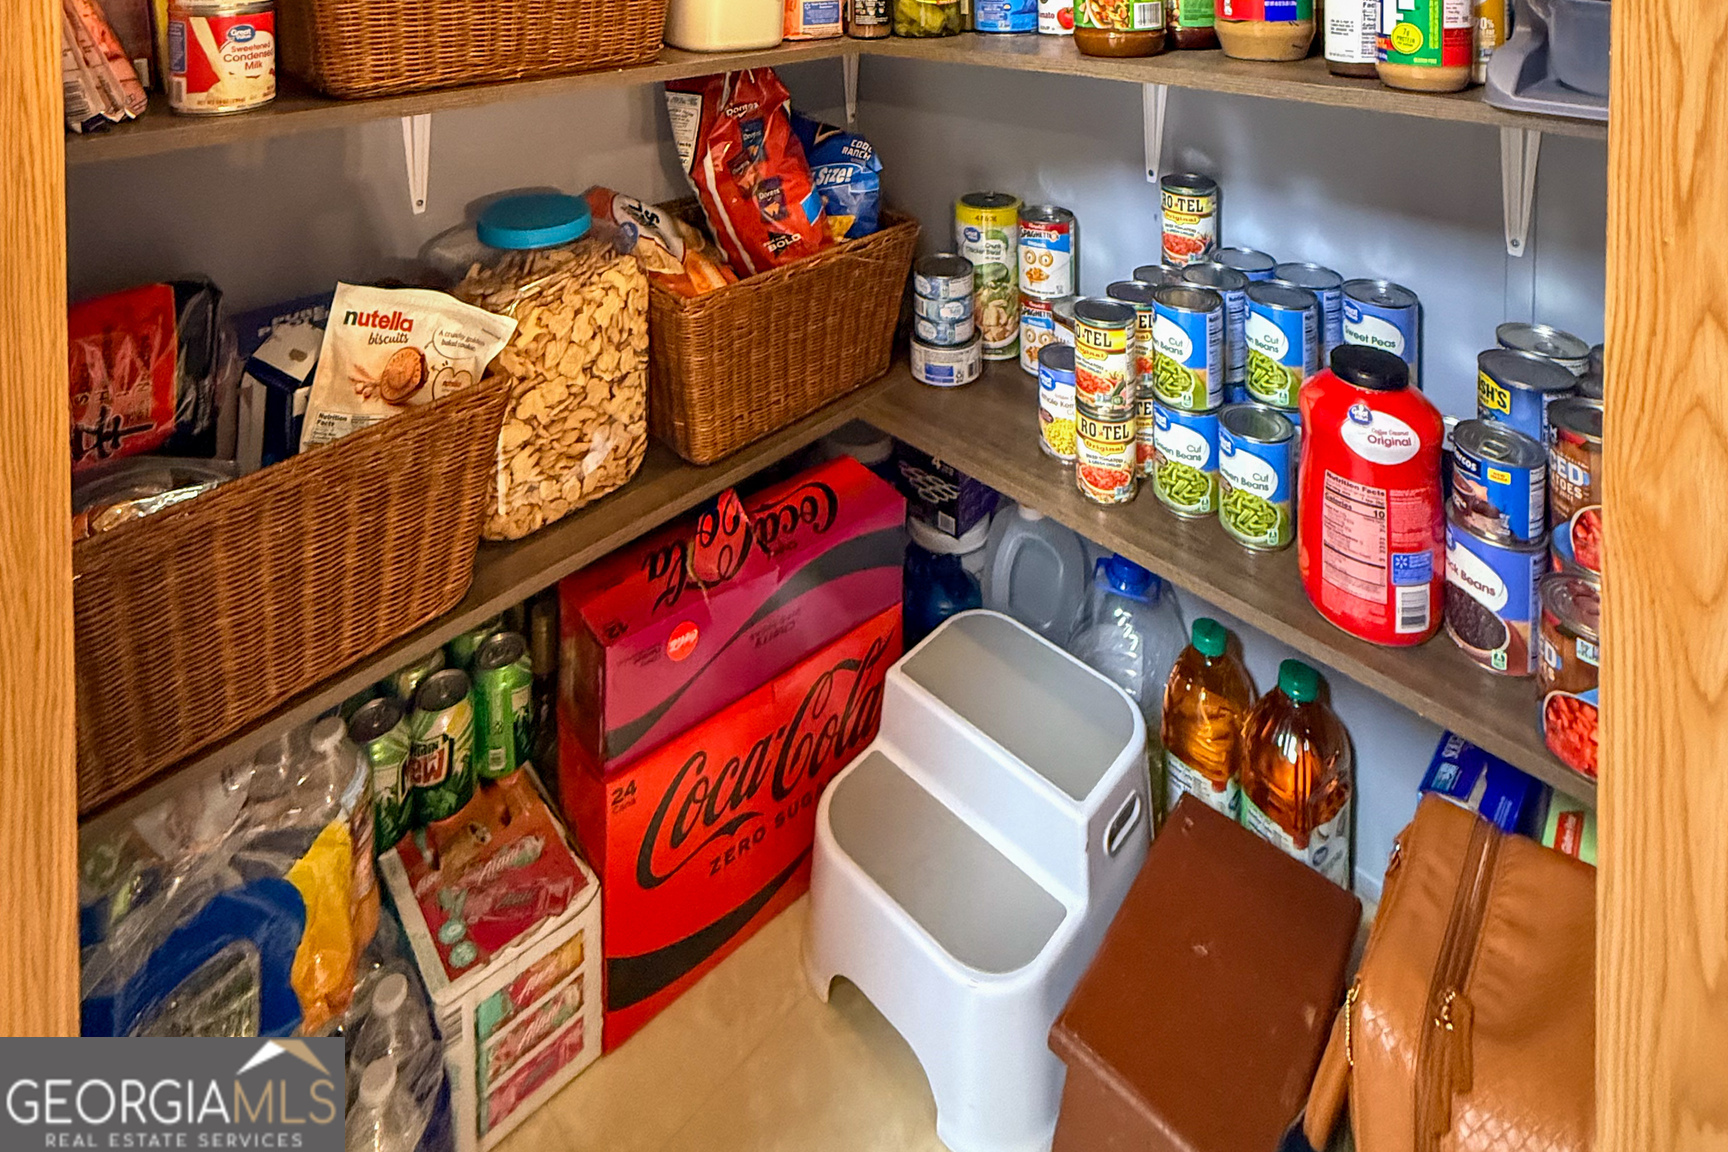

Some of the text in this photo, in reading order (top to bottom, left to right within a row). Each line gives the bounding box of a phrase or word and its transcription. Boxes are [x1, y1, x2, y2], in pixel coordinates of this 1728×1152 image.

[1362, 1, 1376, 9] Fac
[1038, 11, 1055, 20] mato
[230, 27, 252, 38] Great
[230, 41, 271, 53] Sweetened
[223, 49, 274, 63] Condensed
[244, 60, 263, 71] Milk
[841, 145, 873, 161] RANCH
[850, 139, 873, 154] COOL
[816, 166, 853, 186] Size!
[1177, 199, 1204, 213] TEL
[1164, 212, 1198, 224] Original
[768, 233, 802, 254] BOLD
[343, 309, 415, 333] nutella
[1139, 314, 1153, 329] EL
[367, 332, 409, 346] biscuits
[438, 330, 444, 338] A
[1084, 327, 1113, 348] TEL
[1263, 334, 1280, 345] Cut
[1344, 324, 1397, 349] Sweet Peas
[1160, 340, 1184, 357] Beans
[1168, 336, 1184, 348] Cut
[1254, 339, 1279, 354] Beans
[1077, 344, 1105, 359] riginal
[316, 419, 335, 428] Facts
[318, 412, 348, 423] Nutrition
[1081, 417, 1130, 441] RO TEL
[1085, 440, 1124, 452] Original
[1186, 444, 1202, 453] Cut
[1367, 434, 1412, 448] Original
[1175, 449, 1202, 462] Beans
[1550, 448, 1584, 487] CED
[1221, 467, 1270, 492] reen Beans
[1252, 472, 1269, 483] Cut
[1326, 471, 1385, 497] Nutrition Facts
[1552, 473, 1583, 500] TOES
[1324, 491, 1386, 519] Calories 10
[1460, 570, 1497, 598] Beans
[604, 621, 629, 642] 12
[636, 630, 895, 889] Coca-Cola
[610, 779, 637, 807] 24
[709, 825, 769, 878] ZERO
